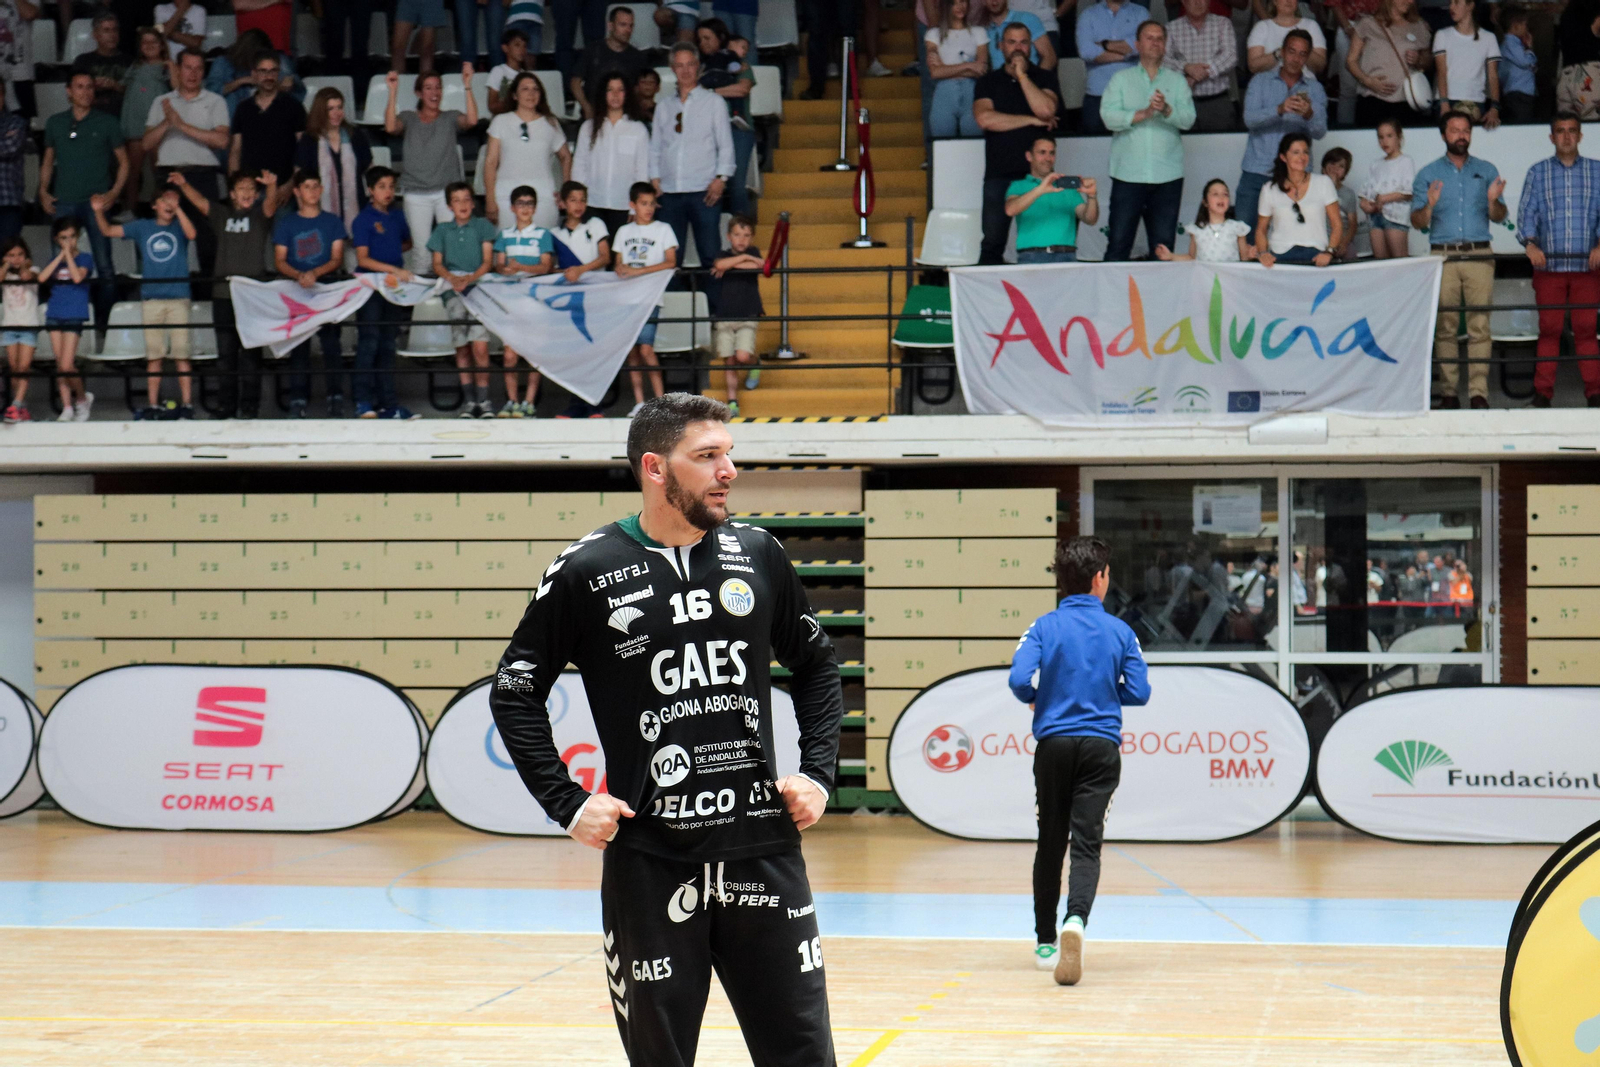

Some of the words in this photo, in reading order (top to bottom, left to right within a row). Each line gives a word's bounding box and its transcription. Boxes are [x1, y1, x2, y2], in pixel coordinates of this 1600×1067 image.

[628, 245, 649, 260] 42
[984, 273, 1398, 375] Andalucía
[718, 554, 752, 563] SEAT
[608, 584, 654, 609] hummel
[669, 589, 713, 625] 16
[615, 634, 649, 651] Fundación
[621, 645, 646, 659] Unicaja
[650, 640, 749, 695] GAES
[705, 693, 759, 715] ABOGAOS
[693, 741, 733, 754] INSTITUTO
[981, 732, 1037, 756] GAO
[1120, 731, 1269, 755] BOGADOS
[653, 752, 690, 779] IQA
[695, 755, 708, 764] DE
[708, 748, 748, 763] ANDALUCÍA
[163, 762, 284, 781] SEAT
[162, 793, 275, 813] CORMOSA
[690, 820, 705, 830] por
[705, 815, 736, 827] construir
[738, 894, 781, 907] PEPE
[797, 935, 823, 973] 16
[632, 957, 673, 981] GAES
